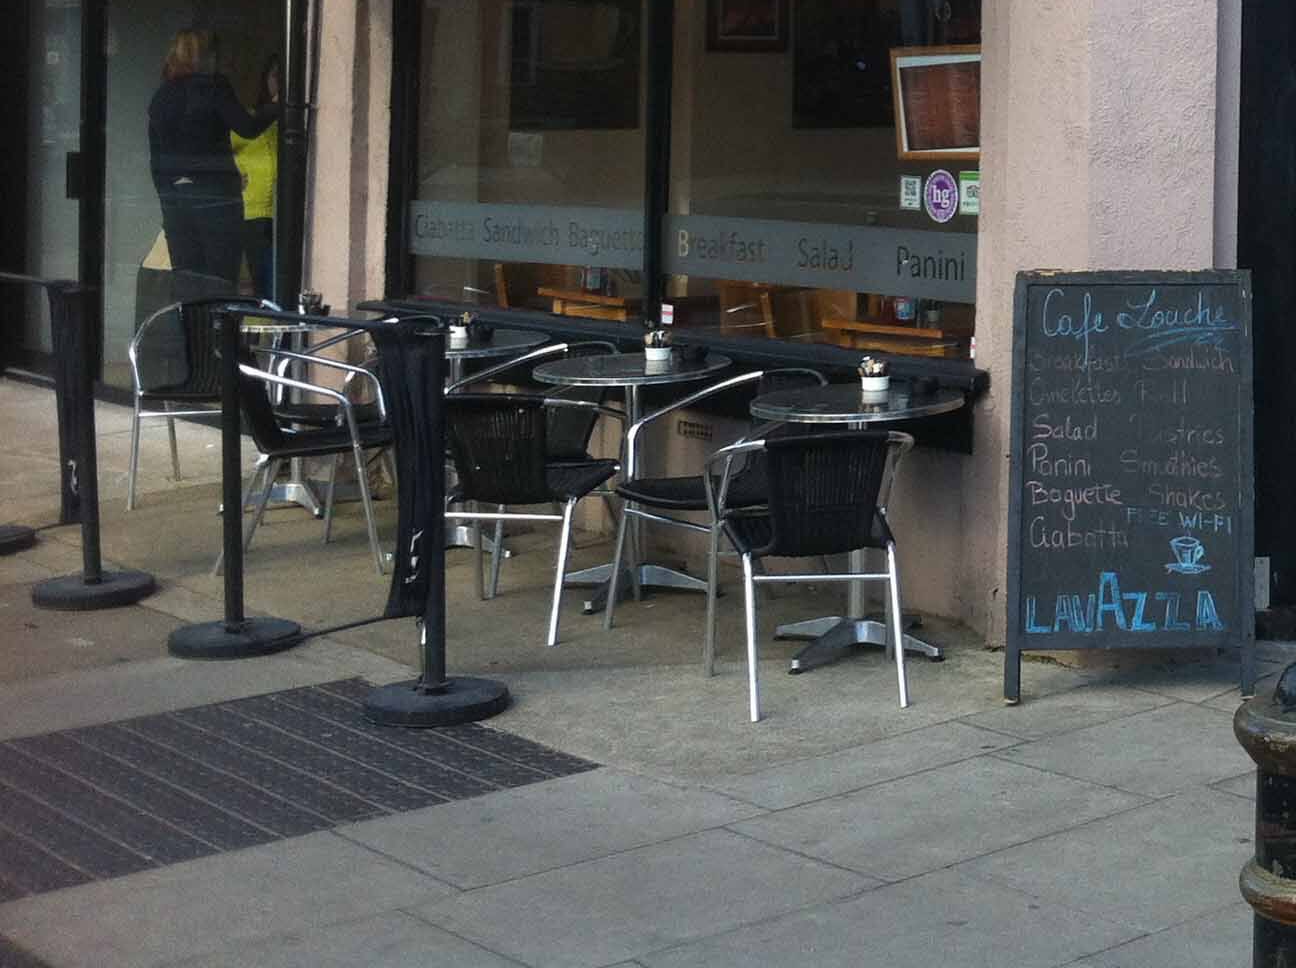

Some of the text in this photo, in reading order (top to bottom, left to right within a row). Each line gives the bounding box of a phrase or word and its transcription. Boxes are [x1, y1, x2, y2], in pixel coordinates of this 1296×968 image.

[932, 184, 951, 209] hg
[482, 216, 560, 246] Sandwich
[677, 229, 769, 265] Breakfast
[796, 237, 855, 272] Salad
[896, 244, 966, 281] Panini
[1042, 288, 1110, 369] Cafe
[1032, 412, 1098, 441] Salad
[1027, 442, 1092, 478] Panini
[1025, 480, 1123, 520] Baguette
[1127, 506, 1168, 526] FEE
[1025, 570, 1226, 634] LAVAZZA
